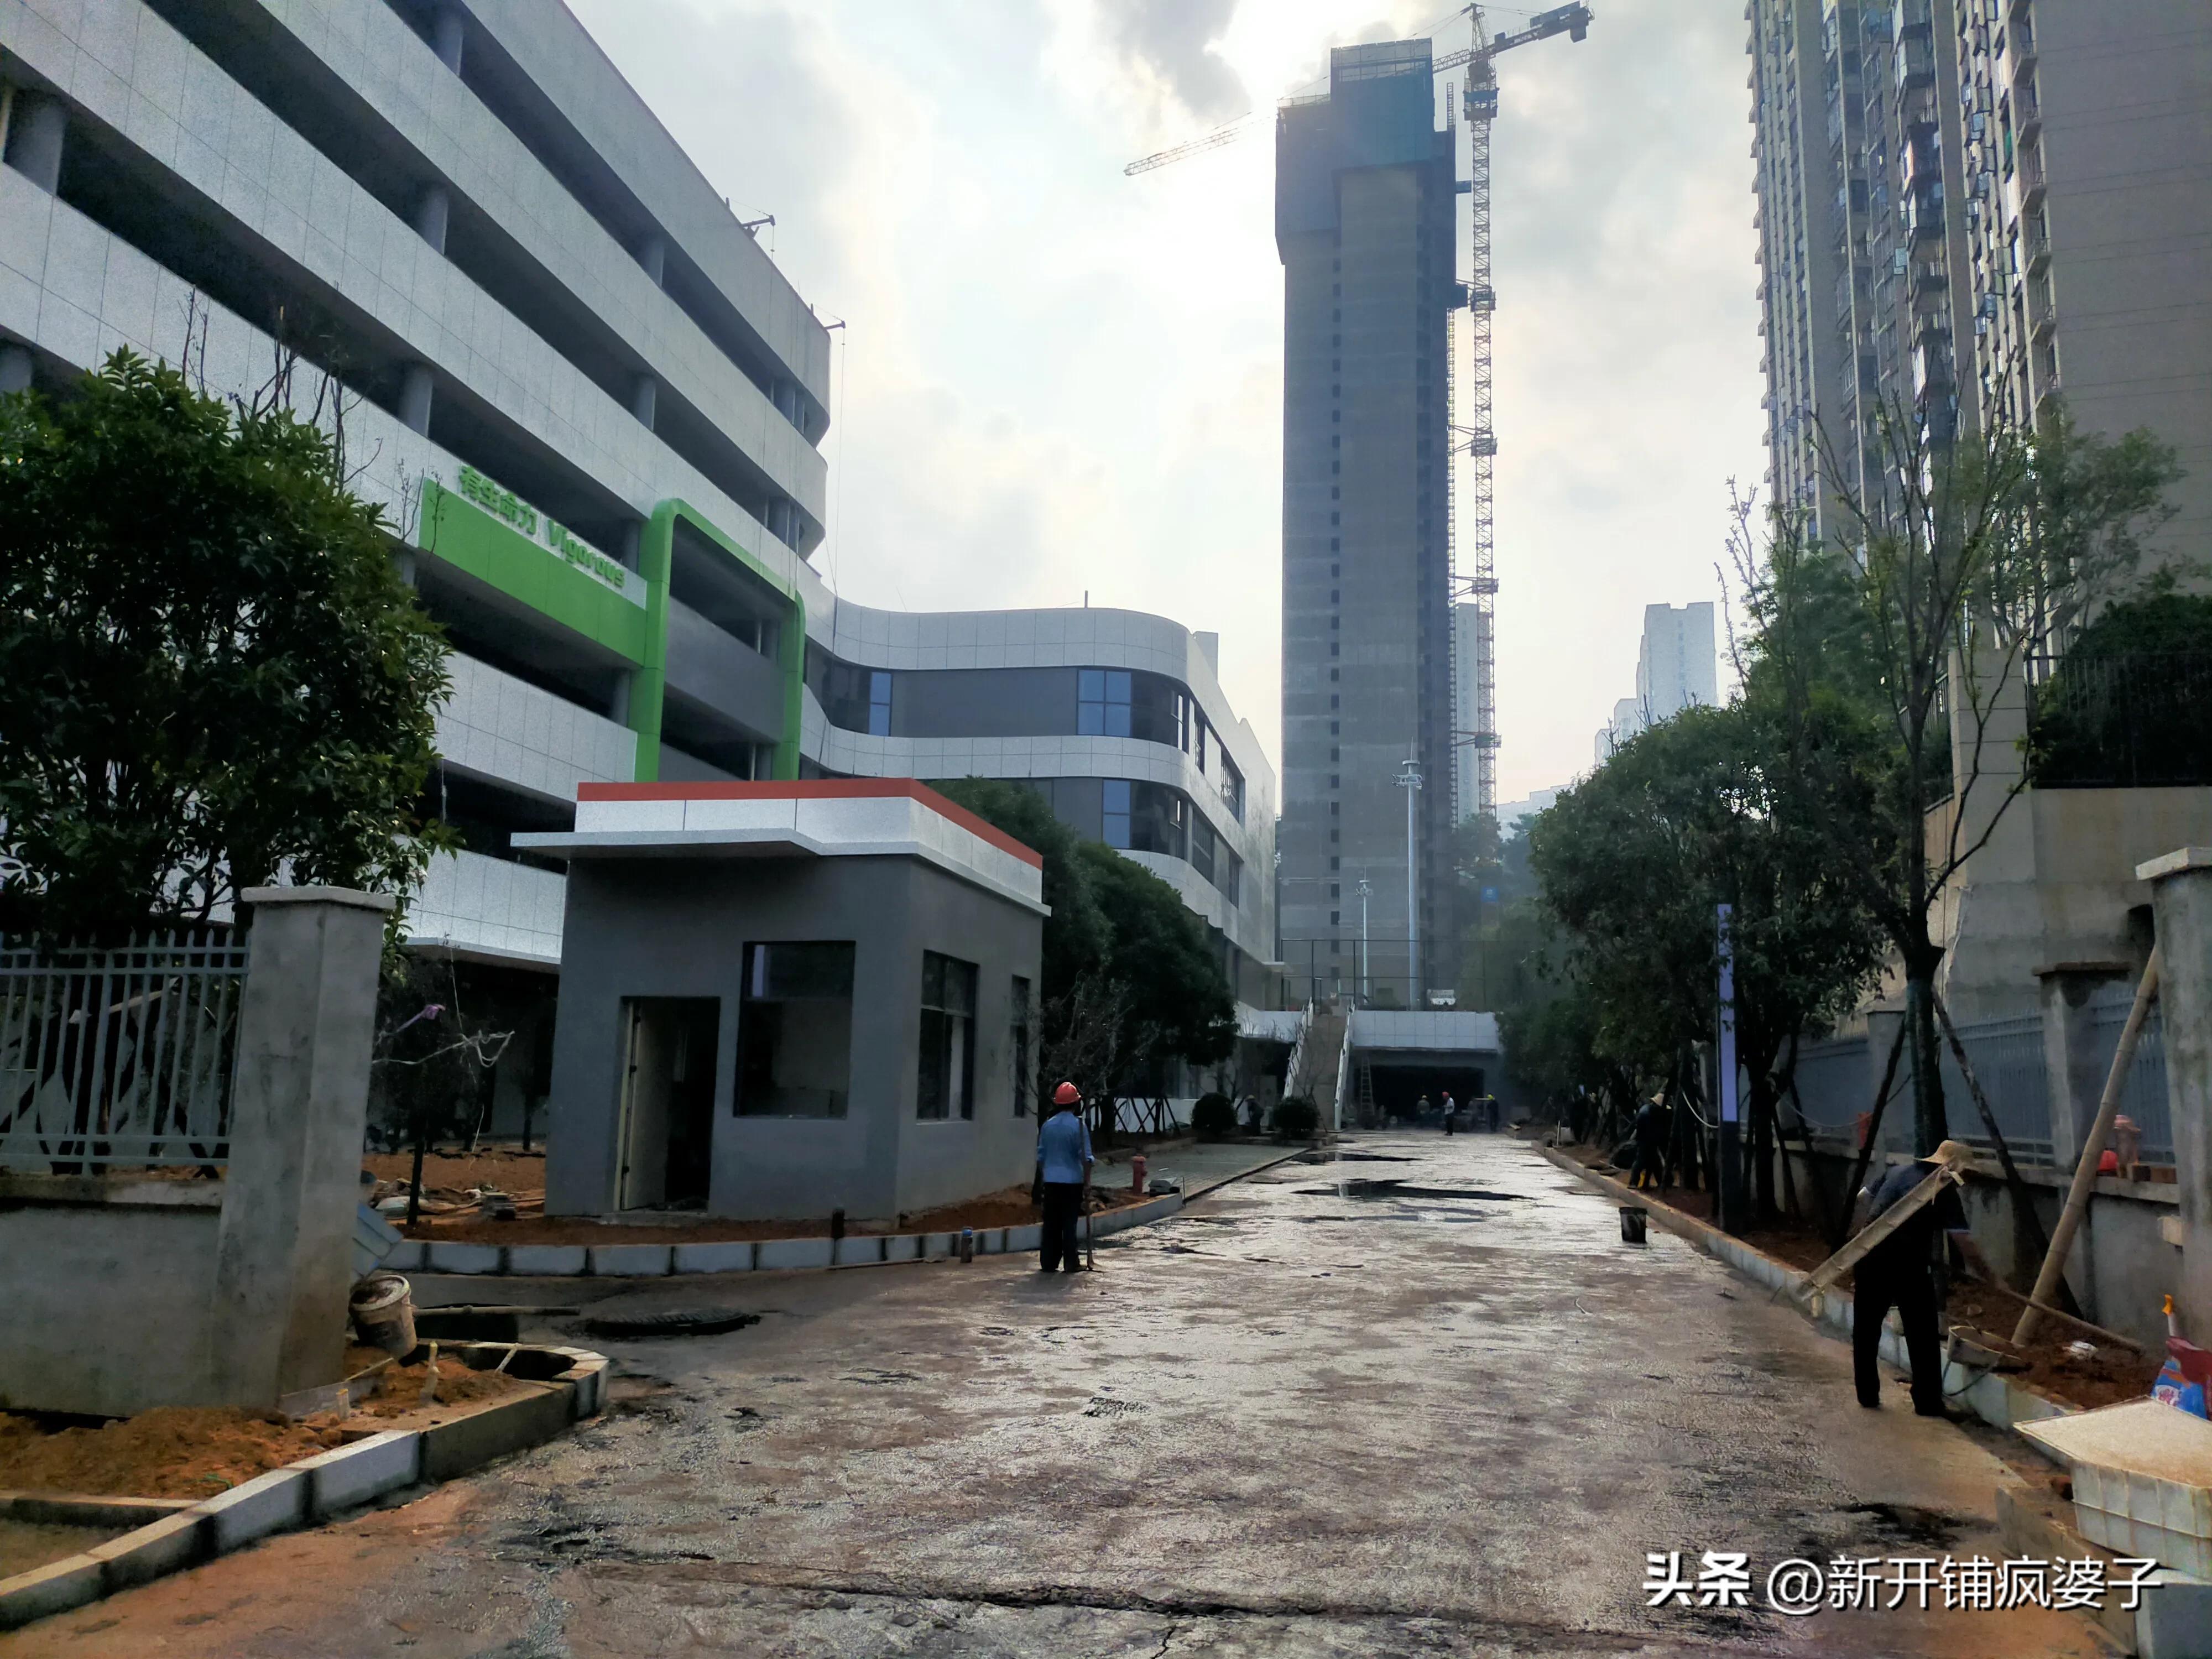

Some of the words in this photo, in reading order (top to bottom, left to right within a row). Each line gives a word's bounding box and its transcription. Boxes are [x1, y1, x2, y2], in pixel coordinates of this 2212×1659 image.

[458, 465, 537, 535] 有生命力
[547, 519, 624, 588] Vigorous
